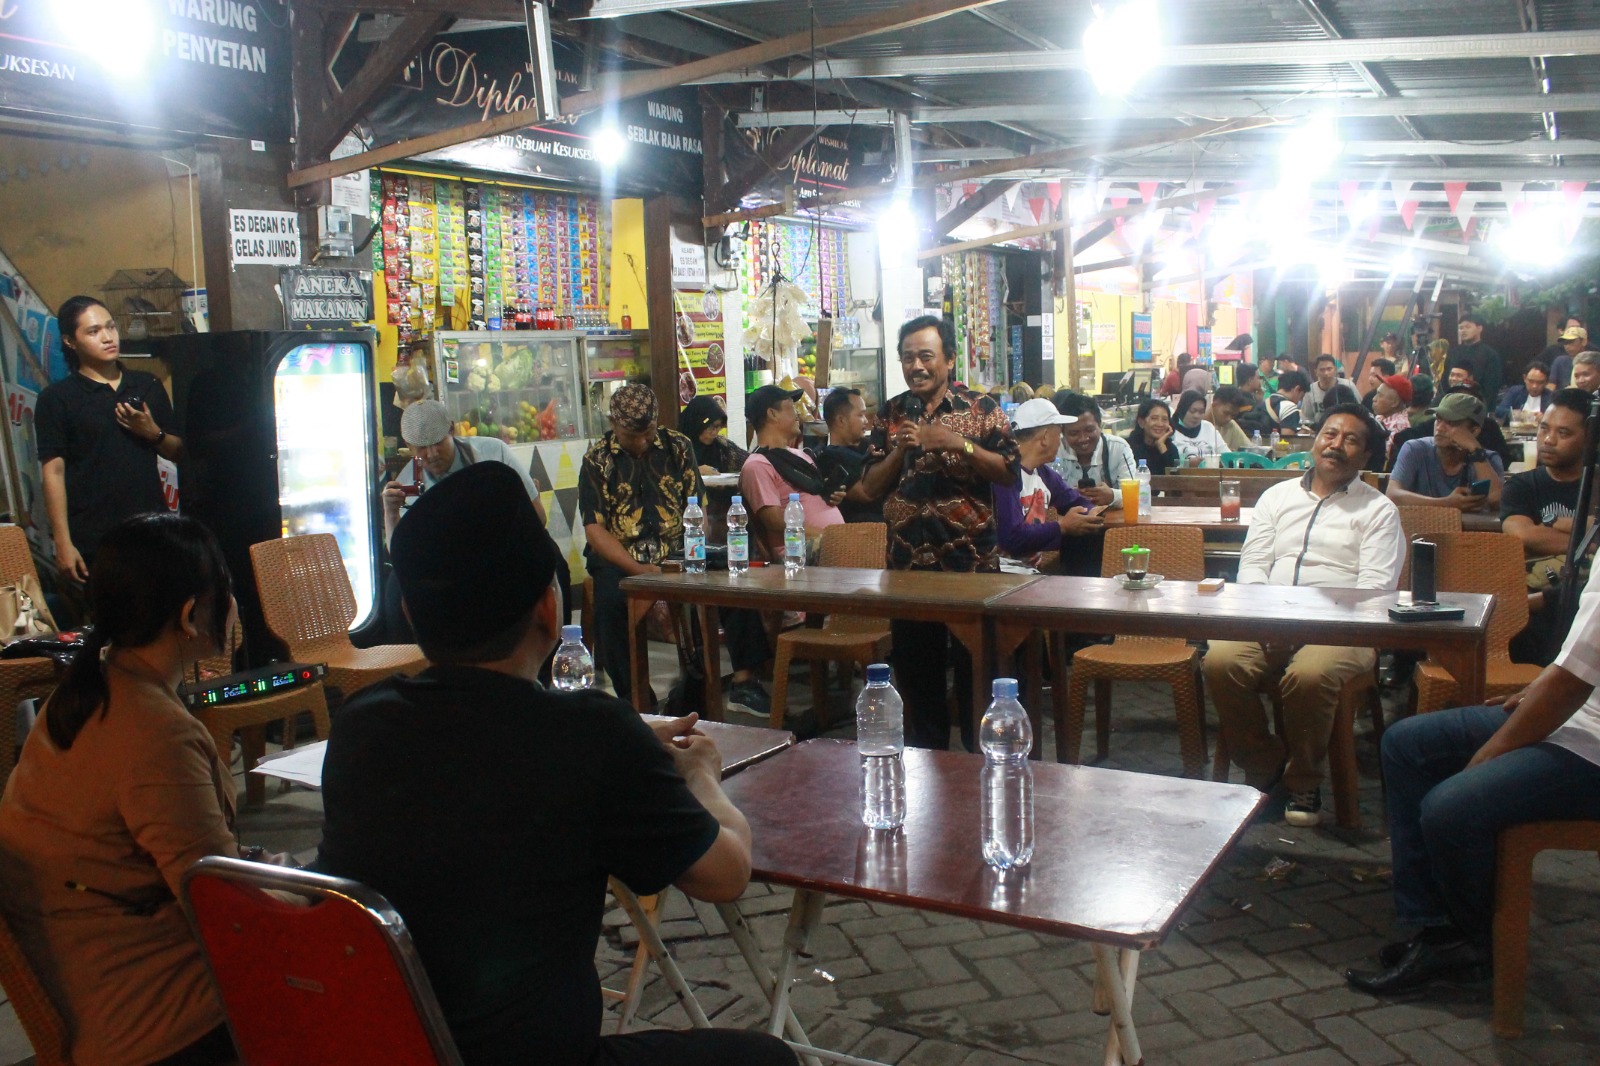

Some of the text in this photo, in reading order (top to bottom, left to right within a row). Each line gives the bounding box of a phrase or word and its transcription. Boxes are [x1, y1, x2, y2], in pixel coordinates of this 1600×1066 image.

[167, 0, 257, 32] WARUNG
[161, 28, 266, 74] PENYETAN
[647, 101, 684, 123] WARUNG
[515, 135, 551, 154] SEBUAH
[627, 125, 703, 155] SEBLAK RAJA RASA
[233, 215, 295, 234] ES DEGAN 6 K
[235, 239, 297, 258] GELAS JUMBO
[295, 276, 361, 297] ANEKA
[291, 299, 368, 321] MAKANAN
